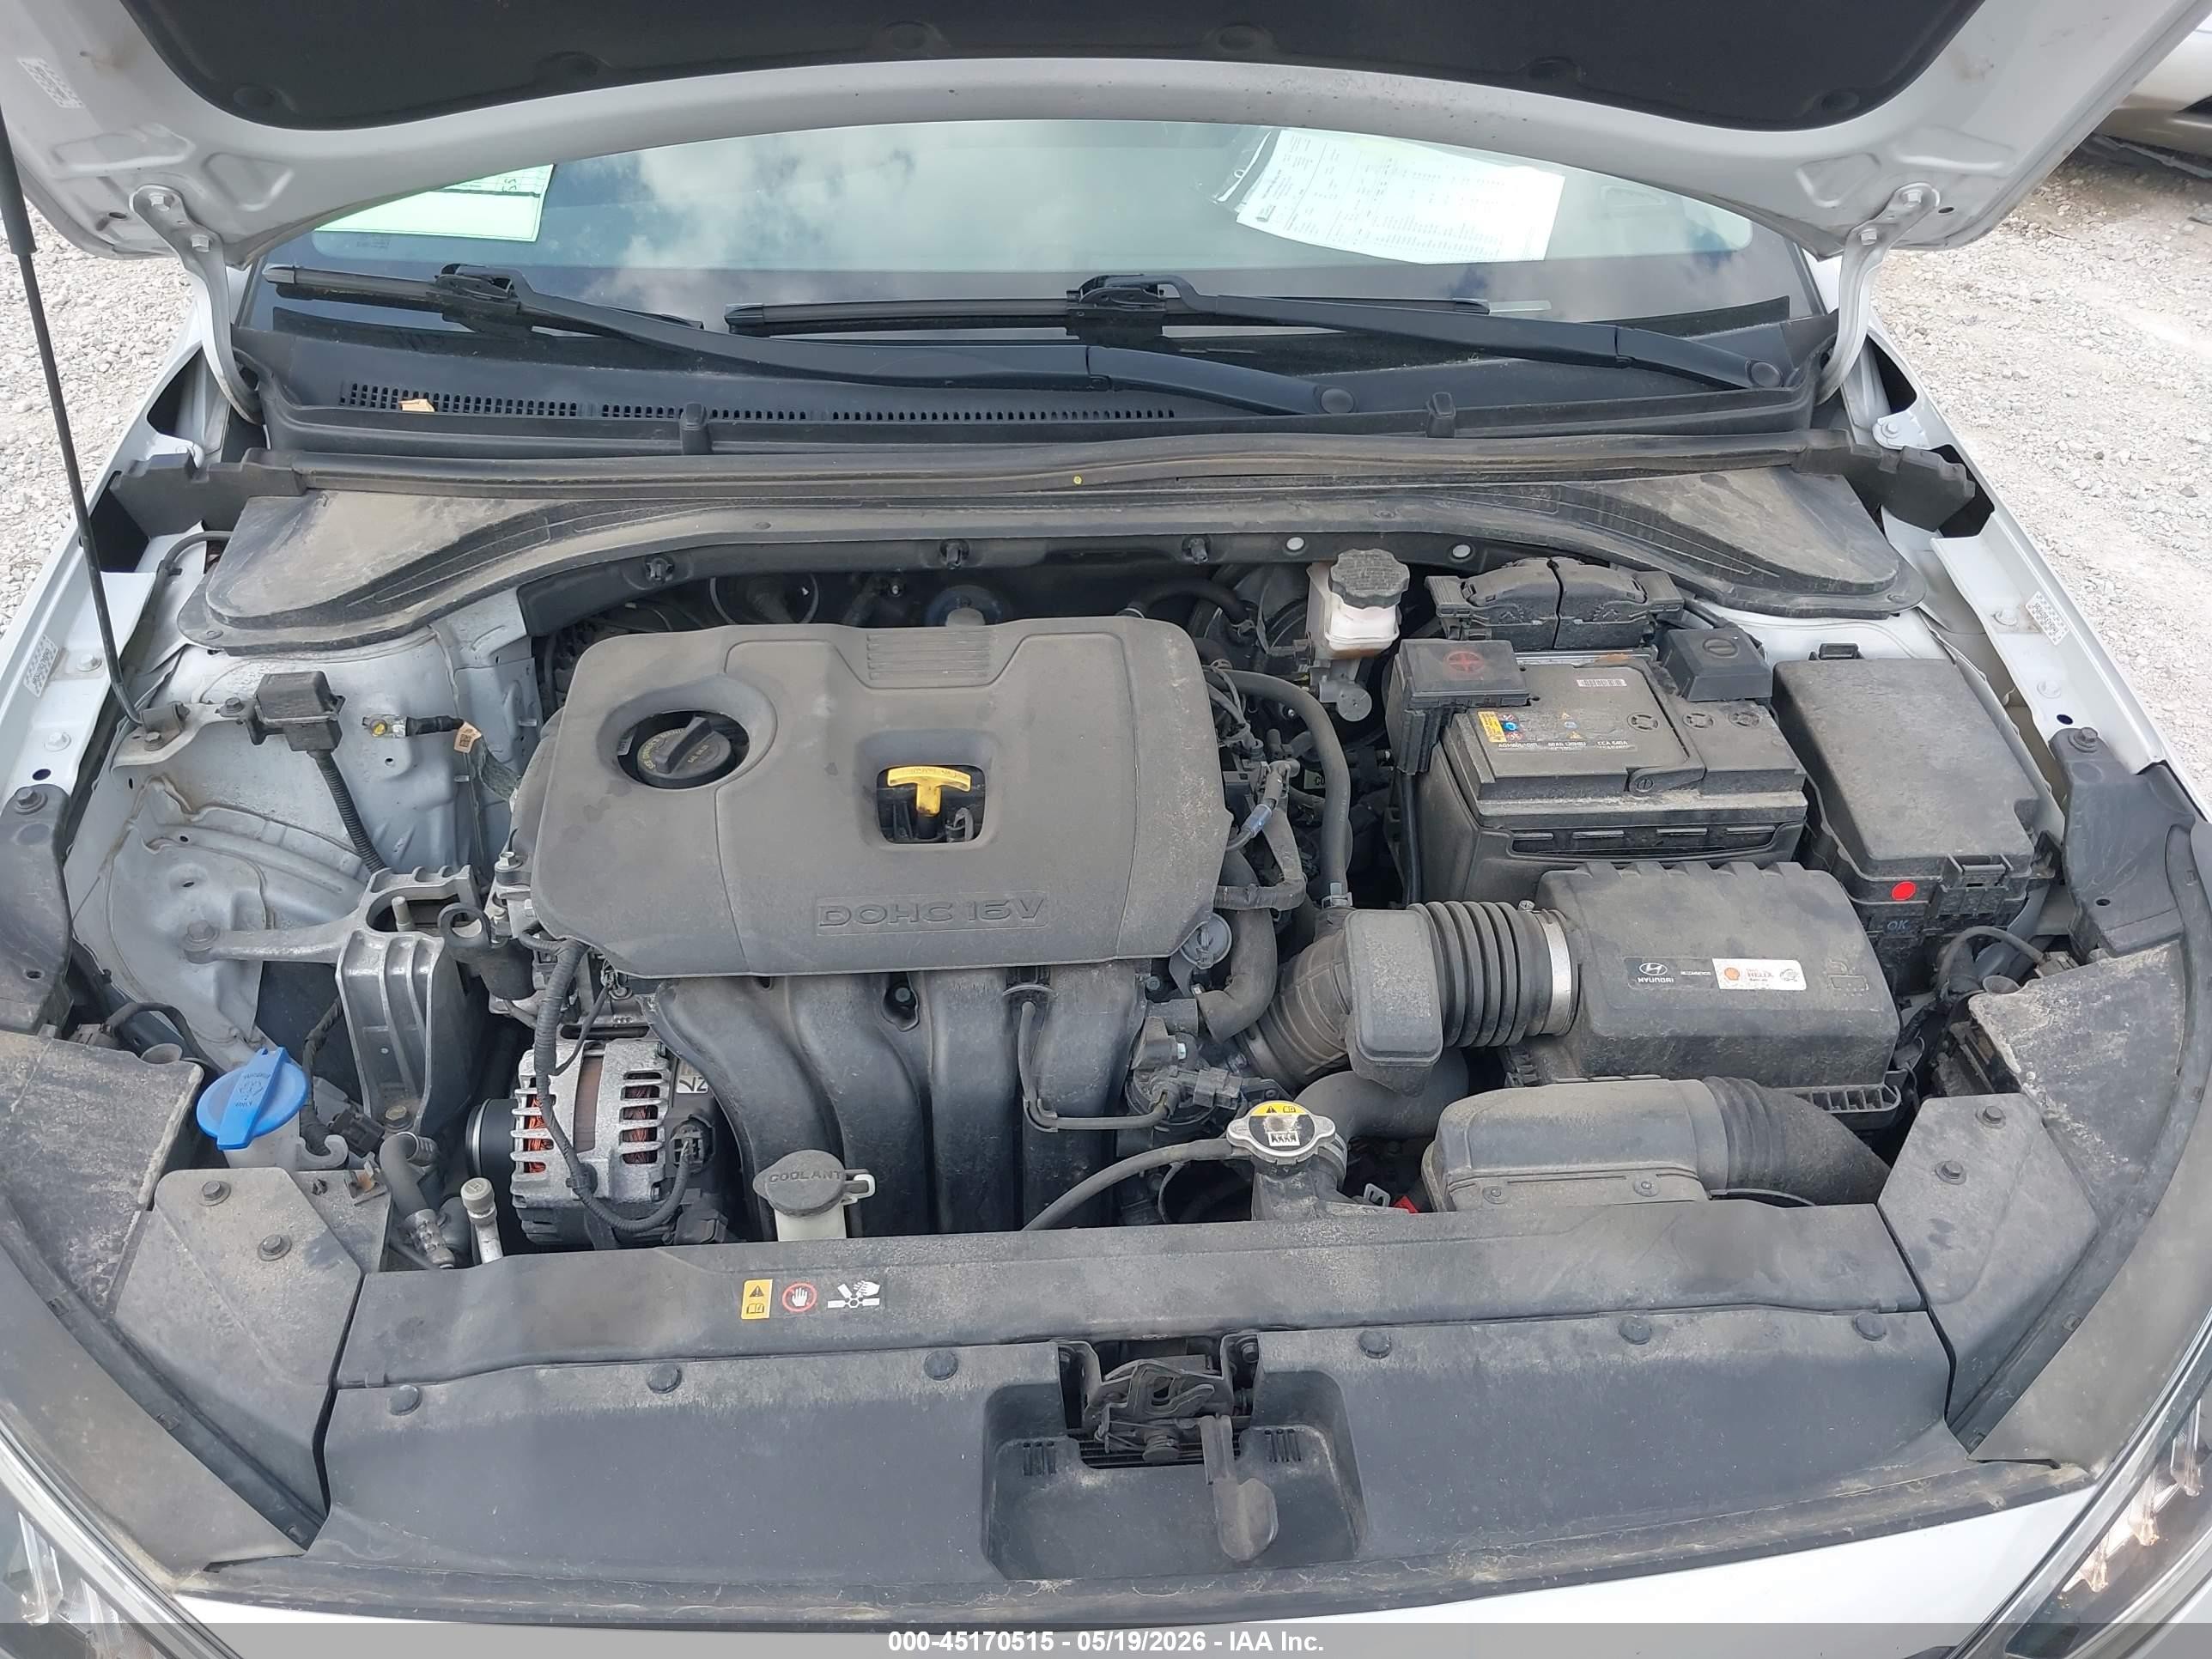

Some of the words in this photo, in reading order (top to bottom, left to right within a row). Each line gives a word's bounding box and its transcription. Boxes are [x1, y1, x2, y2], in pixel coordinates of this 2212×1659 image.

[818, 900, 954, 927] DOHC
[968, 897, 1046, 922] 16V
[1887, 920, 1909, 931] OK
[769, 1170, 842, 1183] COOLANT
